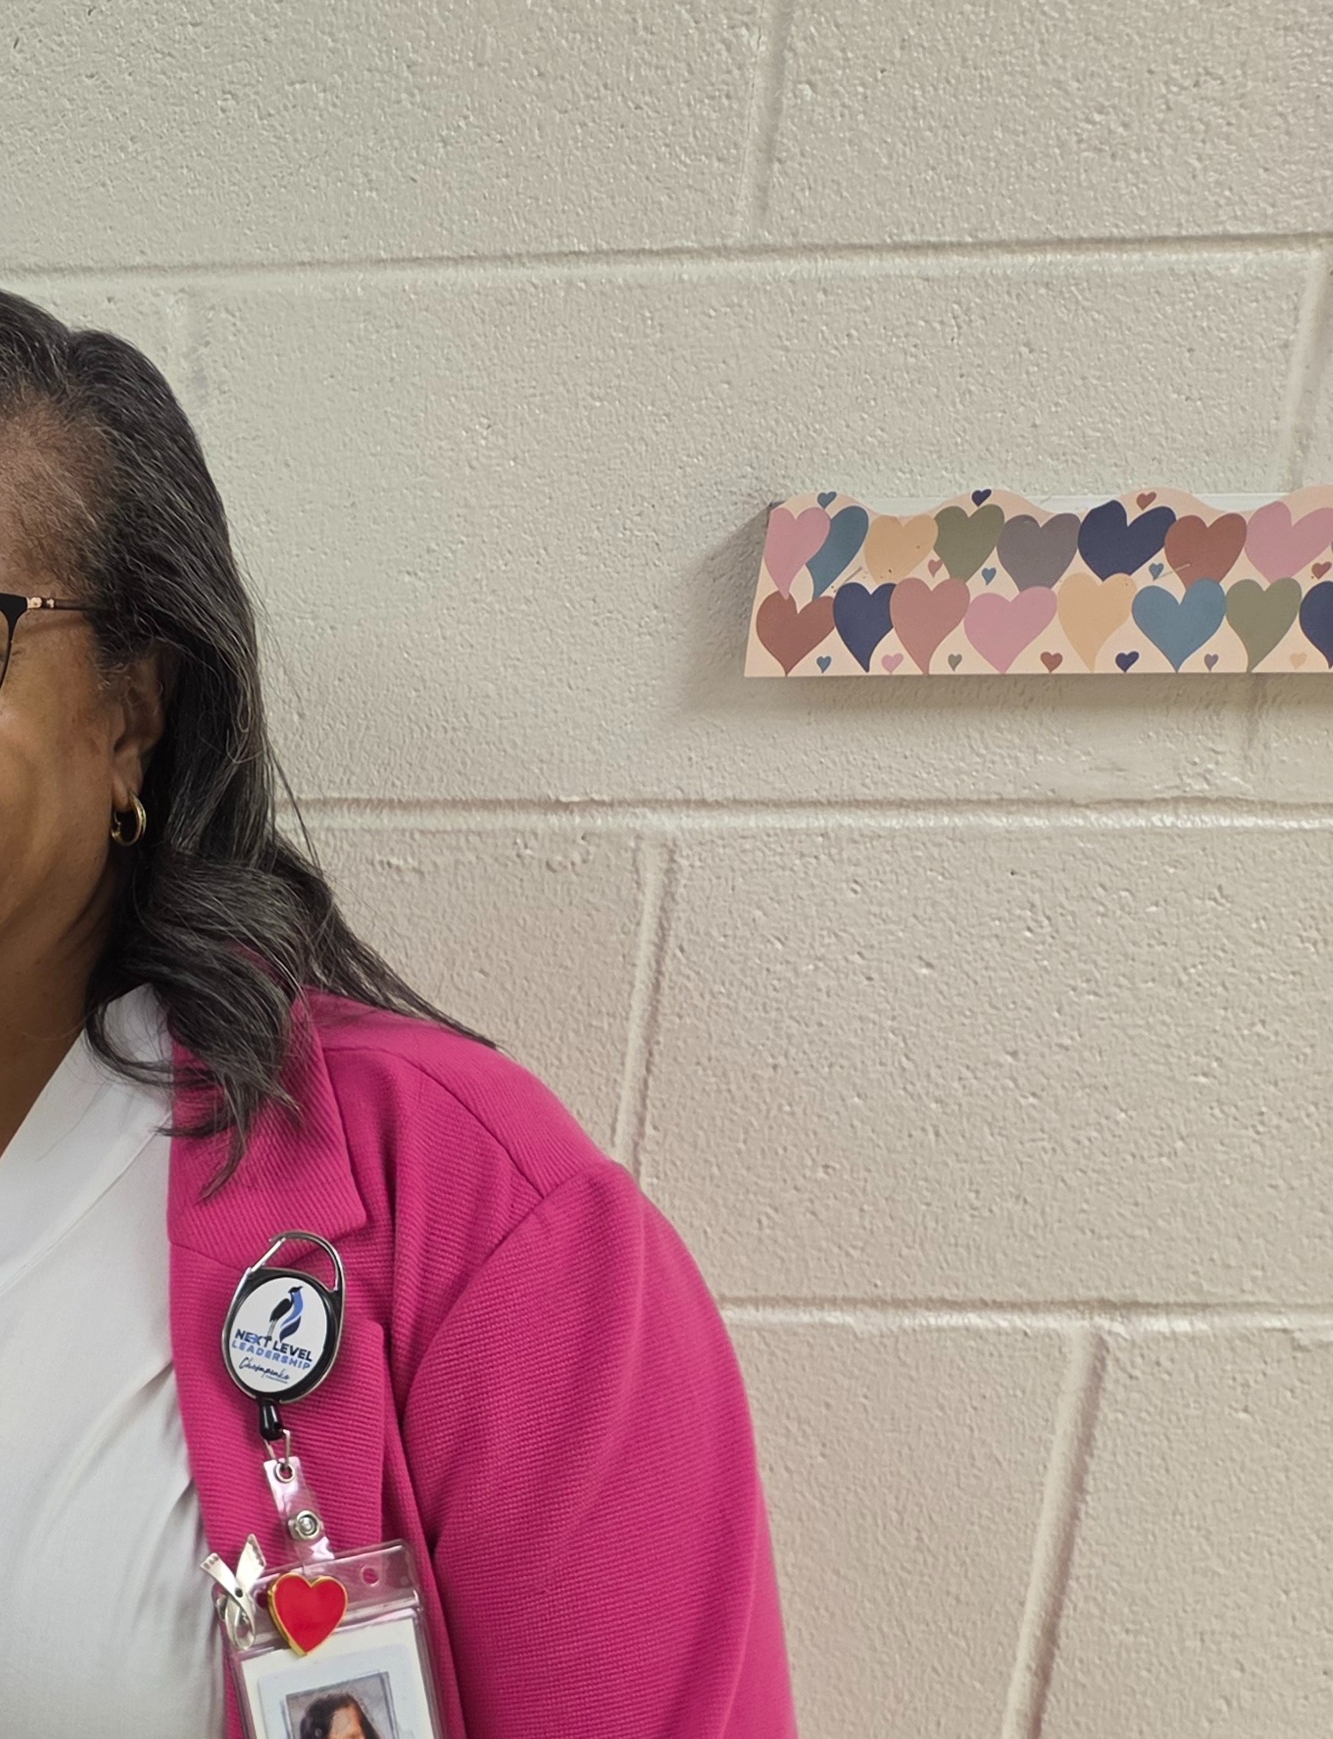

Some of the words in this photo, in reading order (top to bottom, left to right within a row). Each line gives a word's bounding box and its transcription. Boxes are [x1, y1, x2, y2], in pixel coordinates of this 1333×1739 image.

[232, 1340, 311, 1370] LEADERSHIP
[235, 1328, 273, 1348] NEXT
[273, 1340, 312, 1362] LEVEL
